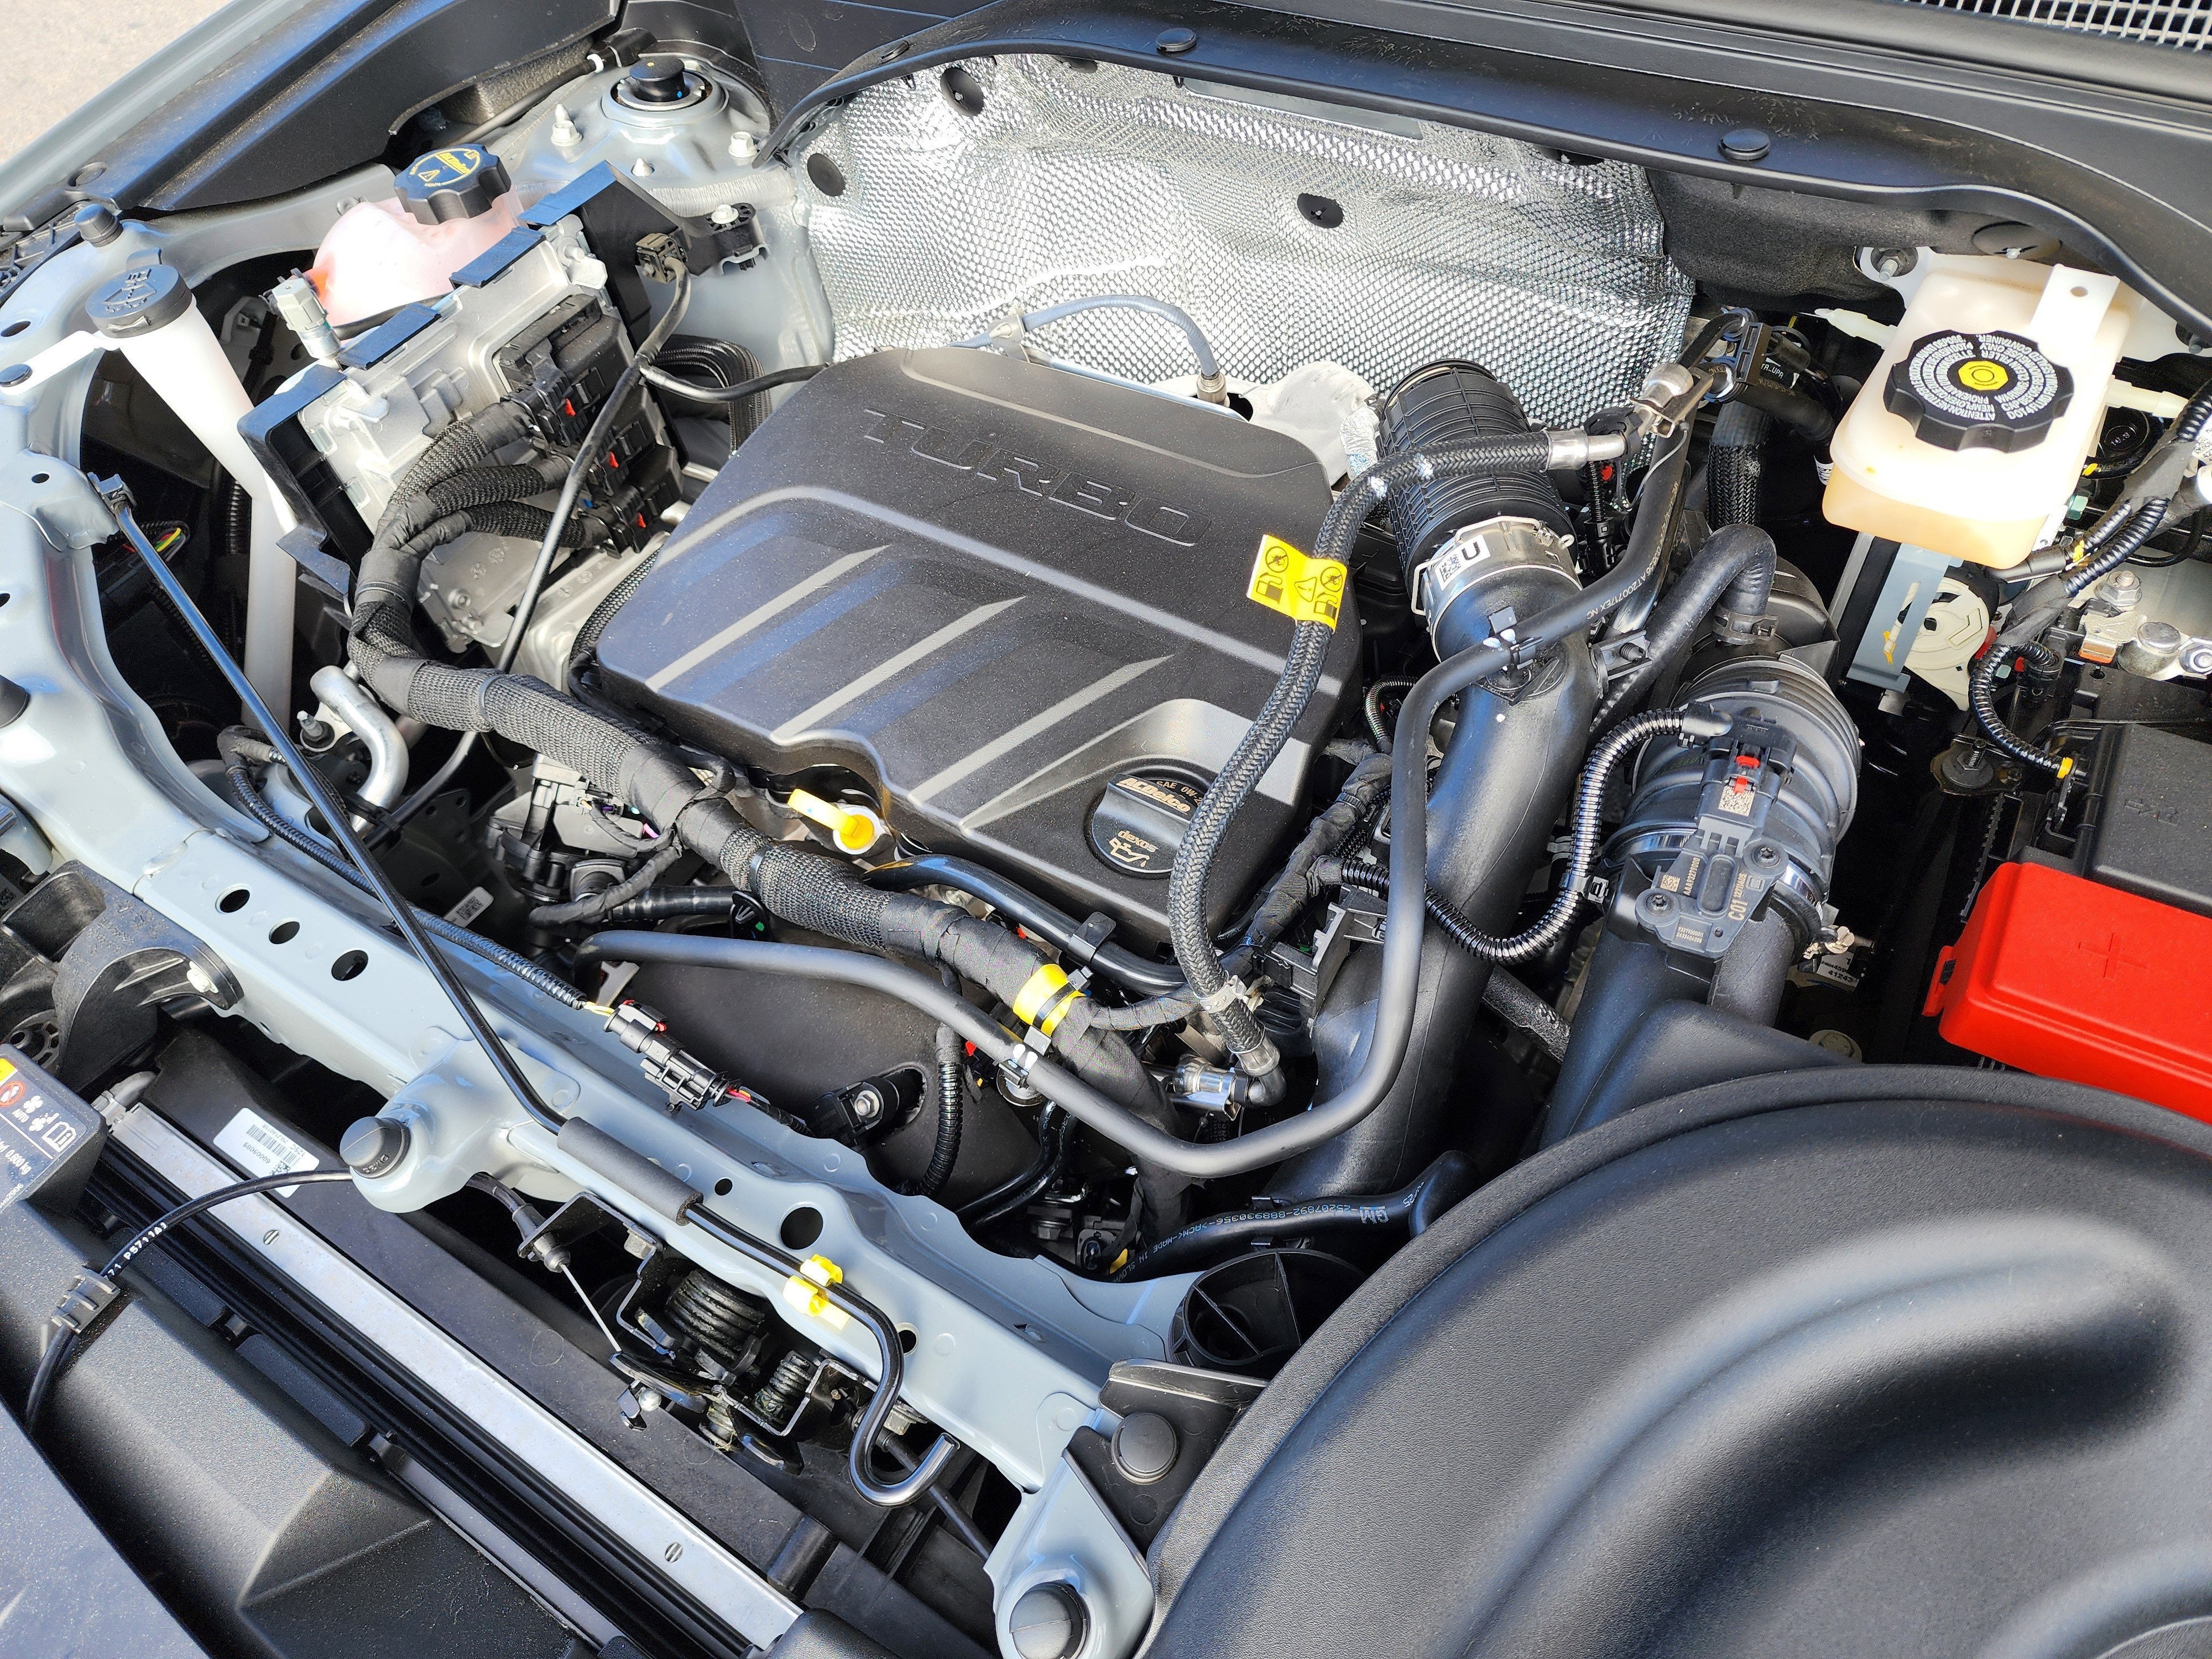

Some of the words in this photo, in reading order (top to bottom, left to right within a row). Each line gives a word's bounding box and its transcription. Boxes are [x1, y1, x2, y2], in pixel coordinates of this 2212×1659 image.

[1950, 342, 1968, 352] DOT
[1964, 342, 1974, 350] 4
[1980, 342, 2007, 353] ONLY
[2003, 347, 2025, 360] USE
[1980, 349, 2015, 364] FILLER
[2000, 399, 2023, 411] CAP
[2006, 407, 2029, 419] DOT
[864, 408, 1213, 546] TURBO
[1461, 541, 1480, 561] U
[1156, 781, 1177, 790] SAE
[1115, 777, 1191, 814] ACDelco
[1118, 830, 1157, 853] dexos
[12, 1108, 30, 1123] AUTO
[20, 1161, 32, 1175] kg
